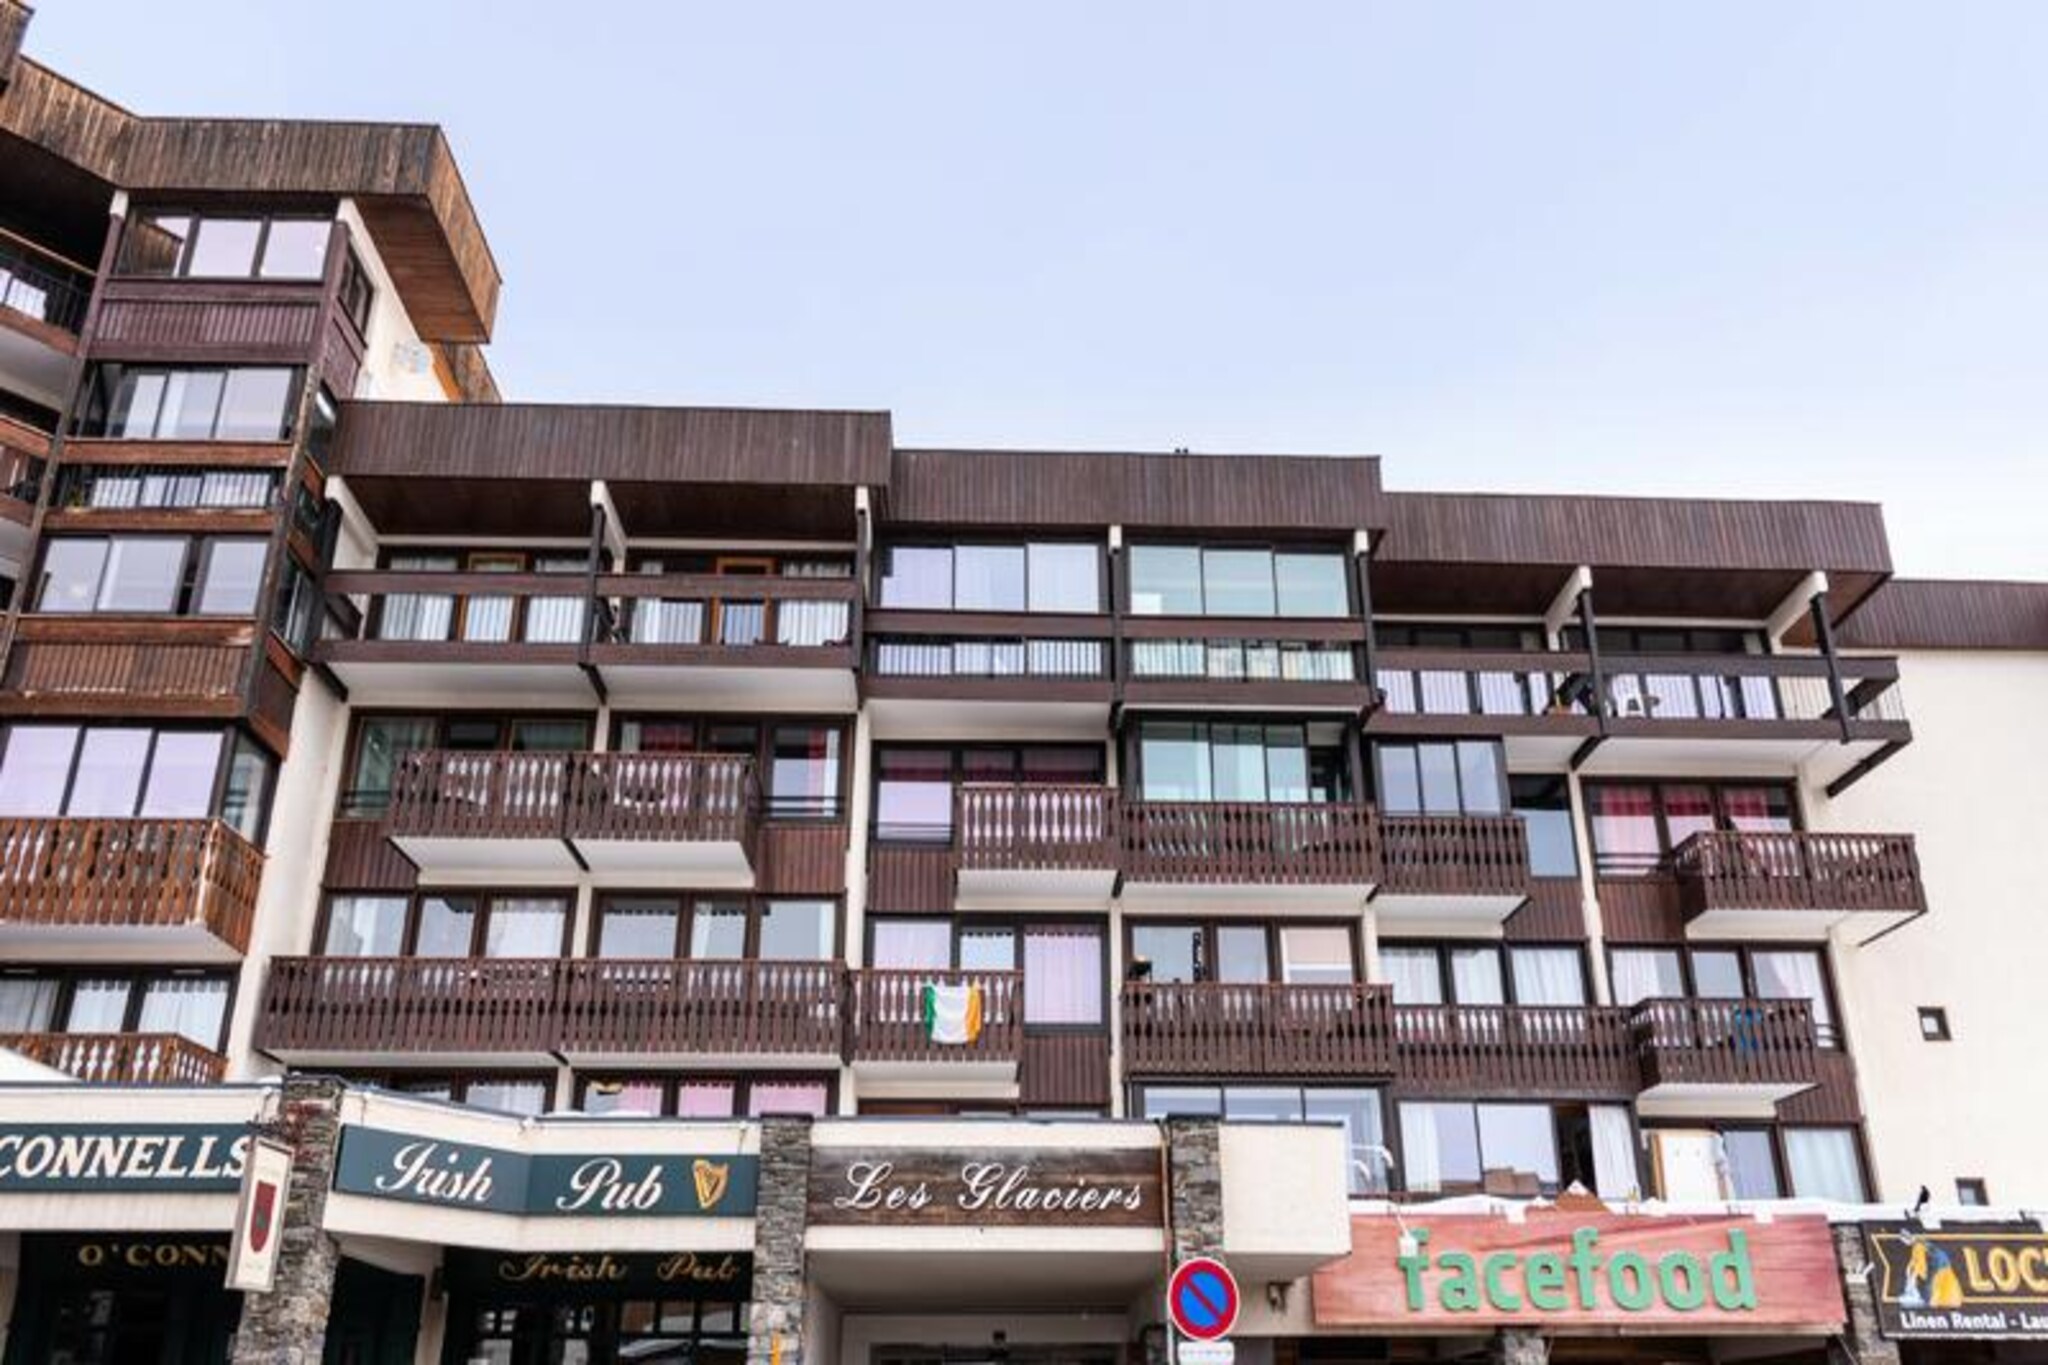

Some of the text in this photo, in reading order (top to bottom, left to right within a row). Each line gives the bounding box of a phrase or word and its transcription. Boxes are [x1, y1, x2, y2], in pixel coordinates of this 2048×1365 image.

[375, 1142, 663, 1212] Irish Pub
[834, 1162, 1142, 1211] Les Glaciers
[499, 1252, 739, 1281] Irish Pub
[1396, 1226, 1757, 1312] facefood
[1963, 1246, 2048, 1292] LOC
[1901, 1312, 1948, 1329] Linen
[1952, 1311, 2007, 1329] Rental
